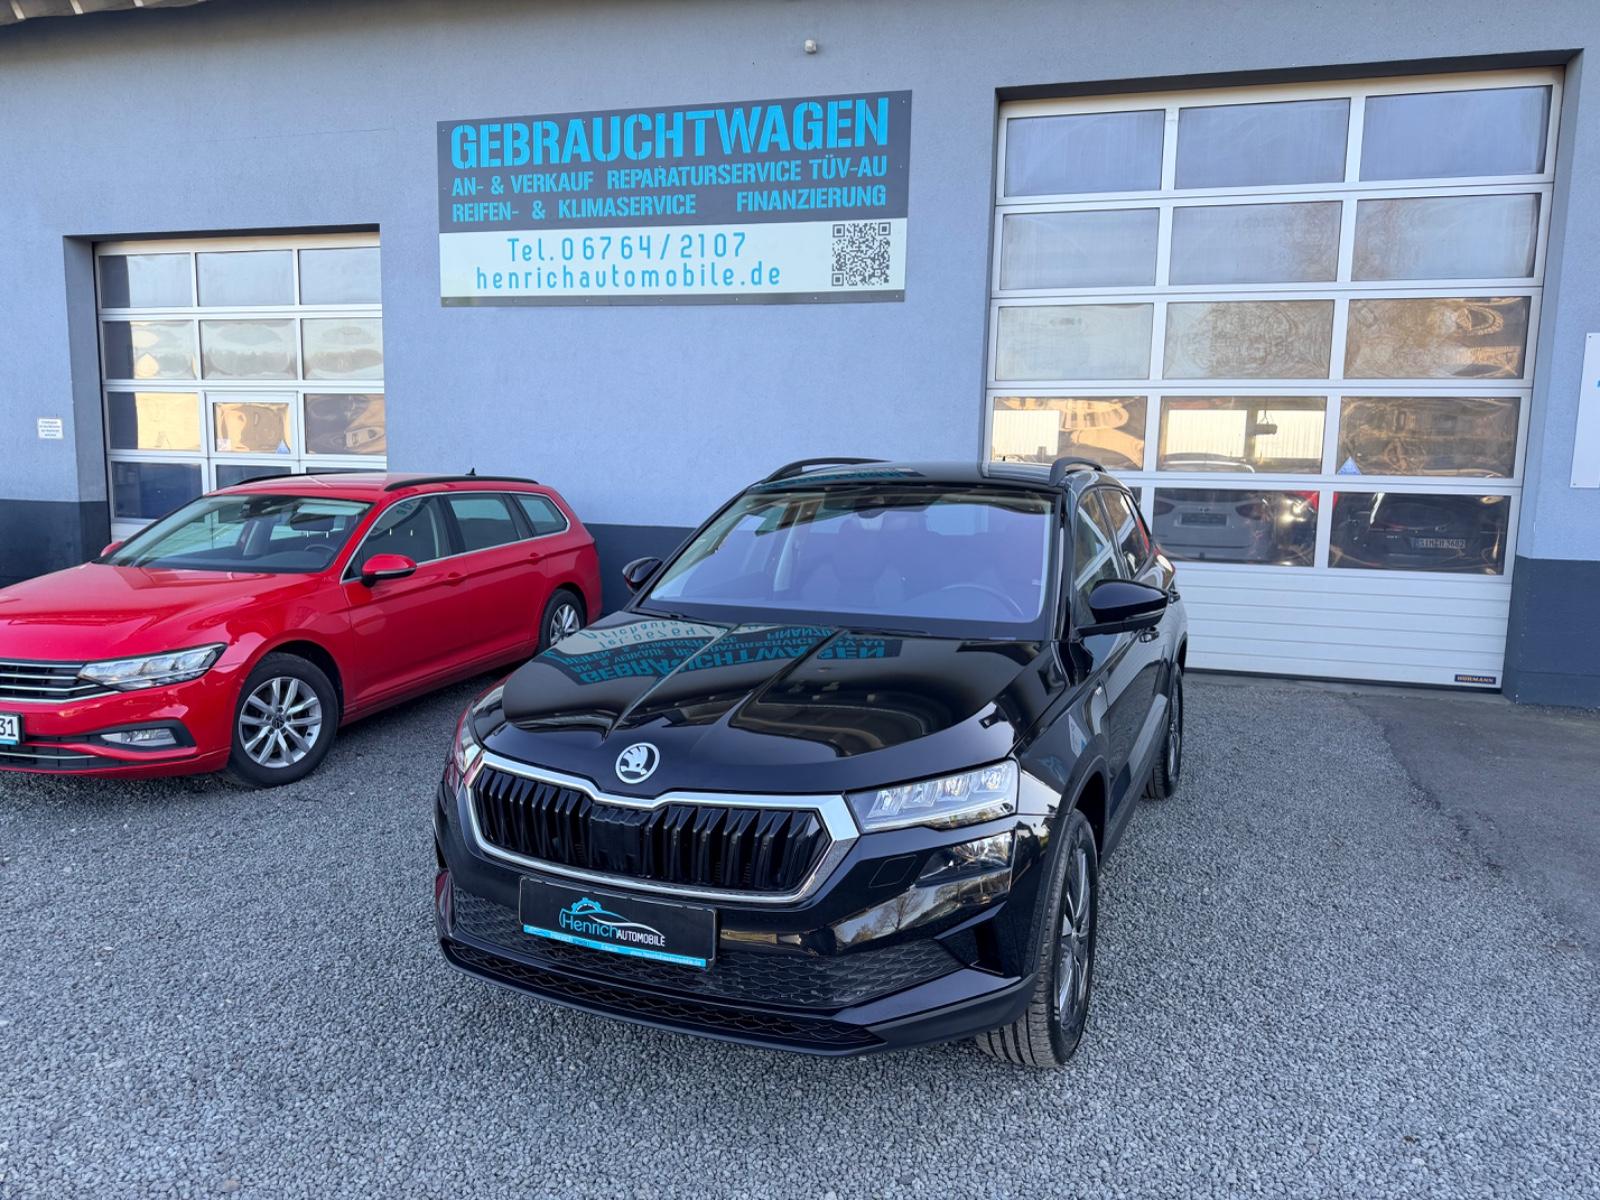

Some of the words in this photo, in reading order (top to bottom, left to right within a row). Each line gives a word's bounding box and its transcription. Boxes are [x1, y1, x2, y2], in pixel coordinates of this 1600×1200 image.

[451, 97, 889, 169] GEBRAUCHTWAGEN
[451, 176, 484, 197] AN-
[490, 175, 505, 195] &
[511, 171, 594, 194] VERKAUF
[607, 160, 801, 190] REPARATURSERVICE
[809, 153, 888, 180] TÜV-AU
[452, 201, 519, 223] REIFEN-
[531, 200, 546, 220] &
[558, 193, 697, 219] KLIMASERVICE
[736, 184, 887, 213] FINANZIERUNG
[476, 260, 781, 290] henrichautomobile.de
[561, 913, 618, 938] Henrich
[616, 928, 666, 947] AUTOMOBILE
